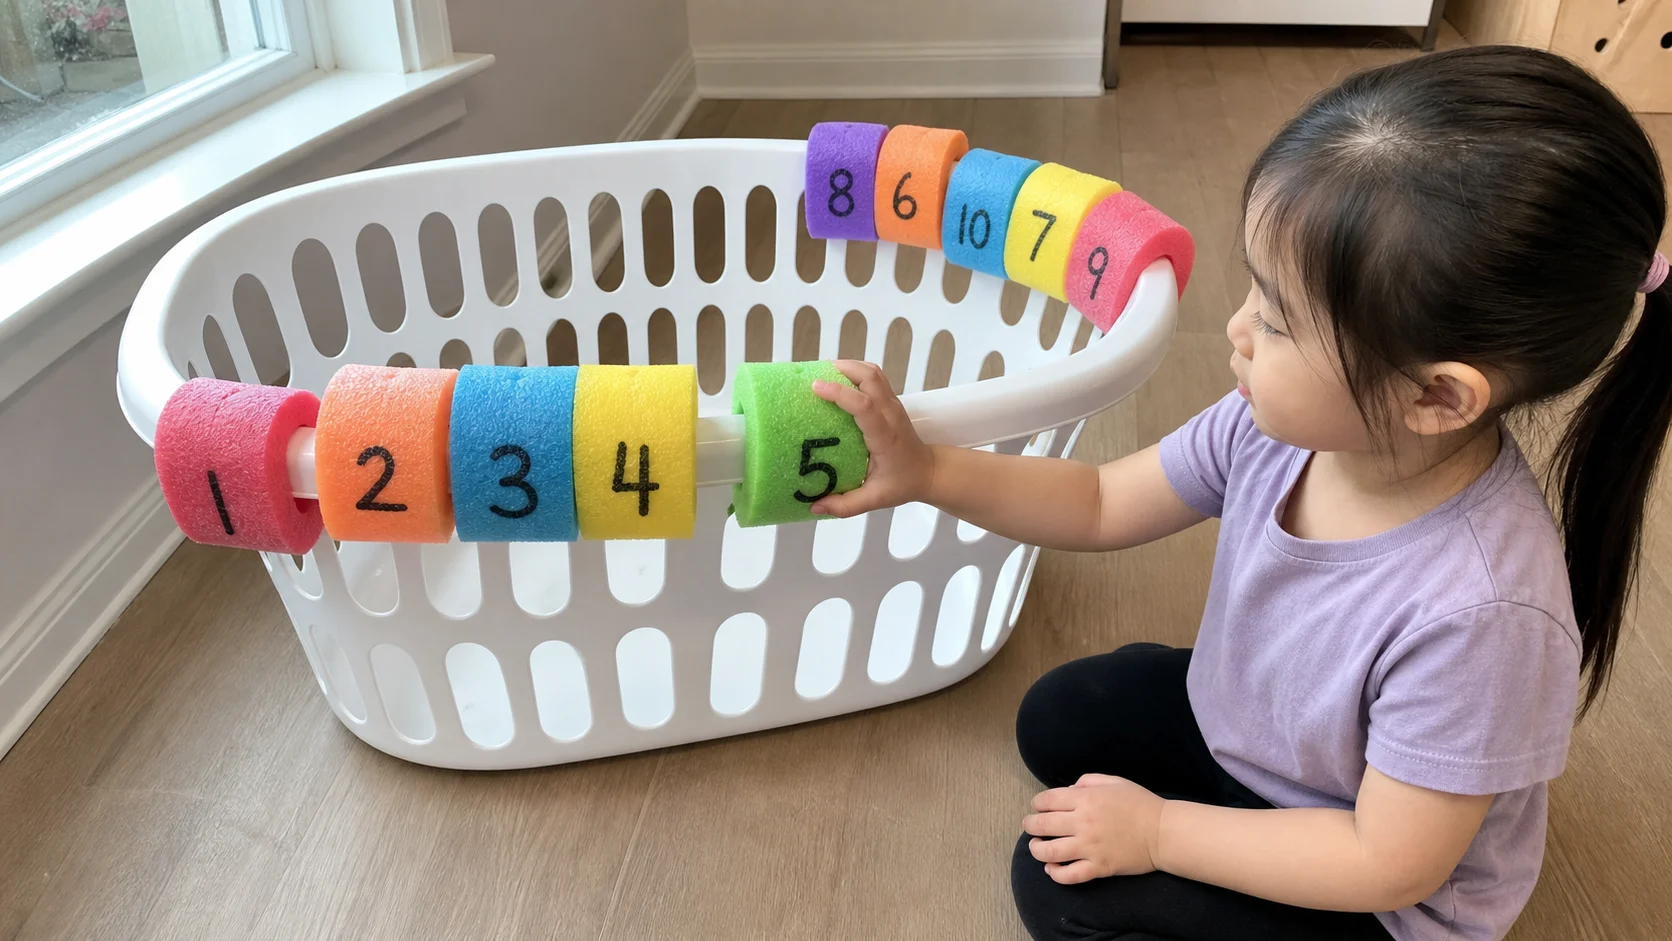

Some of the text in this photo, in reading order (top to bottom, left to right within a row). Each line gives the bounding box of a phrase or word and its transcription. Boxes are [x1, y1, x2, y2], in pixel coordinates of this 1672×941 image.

[827, 168, 855, 217] 8
[892, 171, 917, 220] 6
[958, 203, 991, 250] 10
[1030, 209, 1057, 262] 7
[1087, 246, 1109, 300] 9
[355, 445, 408, 513] 2
[488, 444, 539, 519] 3
[611, 441, 660, 517] 4
[793, 437, 841, 504] 5
[207, 470, 236, 536] 1
